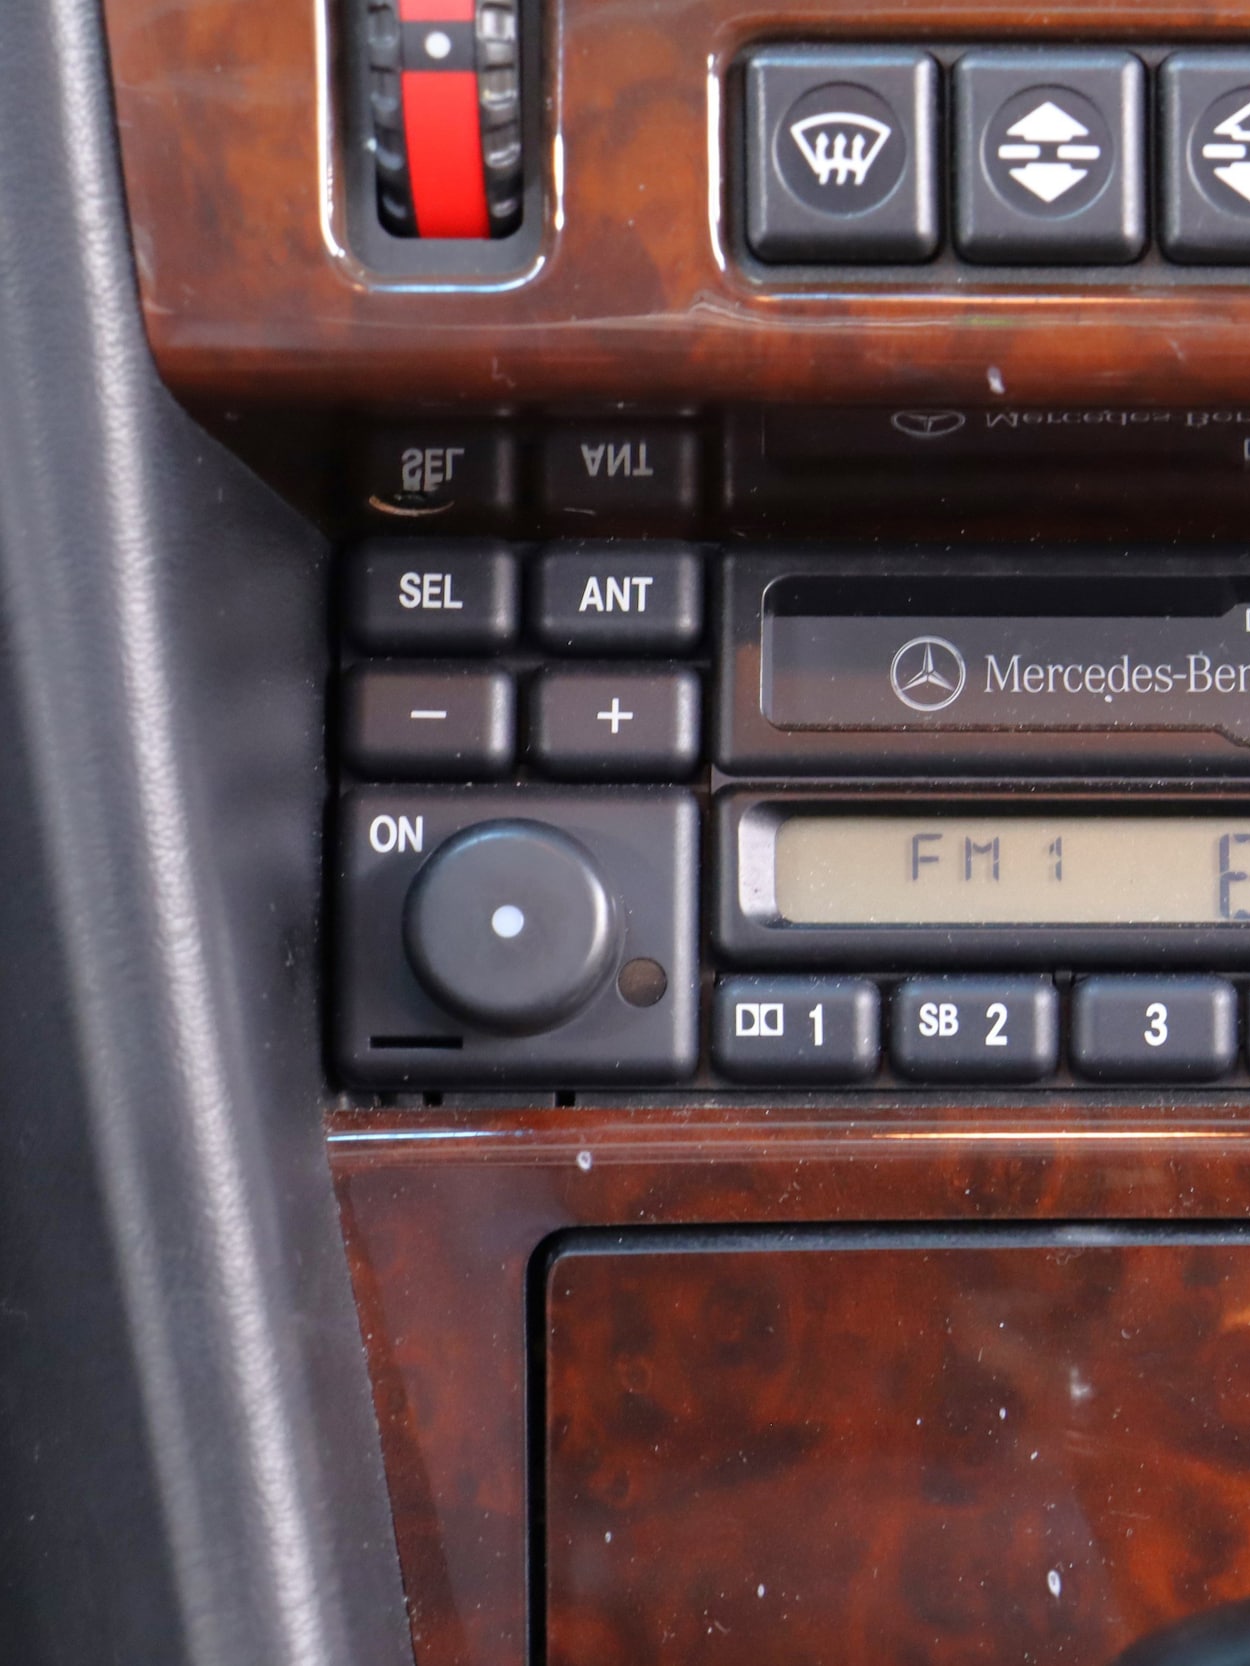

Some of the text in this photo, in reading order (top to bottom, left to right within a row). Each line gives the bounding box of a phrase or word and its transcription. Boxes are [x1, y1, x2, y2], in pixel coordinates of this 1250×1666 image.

[399, 572, 463, 609] SEL
[579, 576, 653, 612] ANT
[369, 814, 424, 853] ON
[911, 834, 1000, 881] FM
[1046, 834, 1064, 881] 1
[809, 1003, 823, 1046] 1
[918, 1002, 1008, 1046] SB 2
[1144, 1002, 1168, 1047] 3
